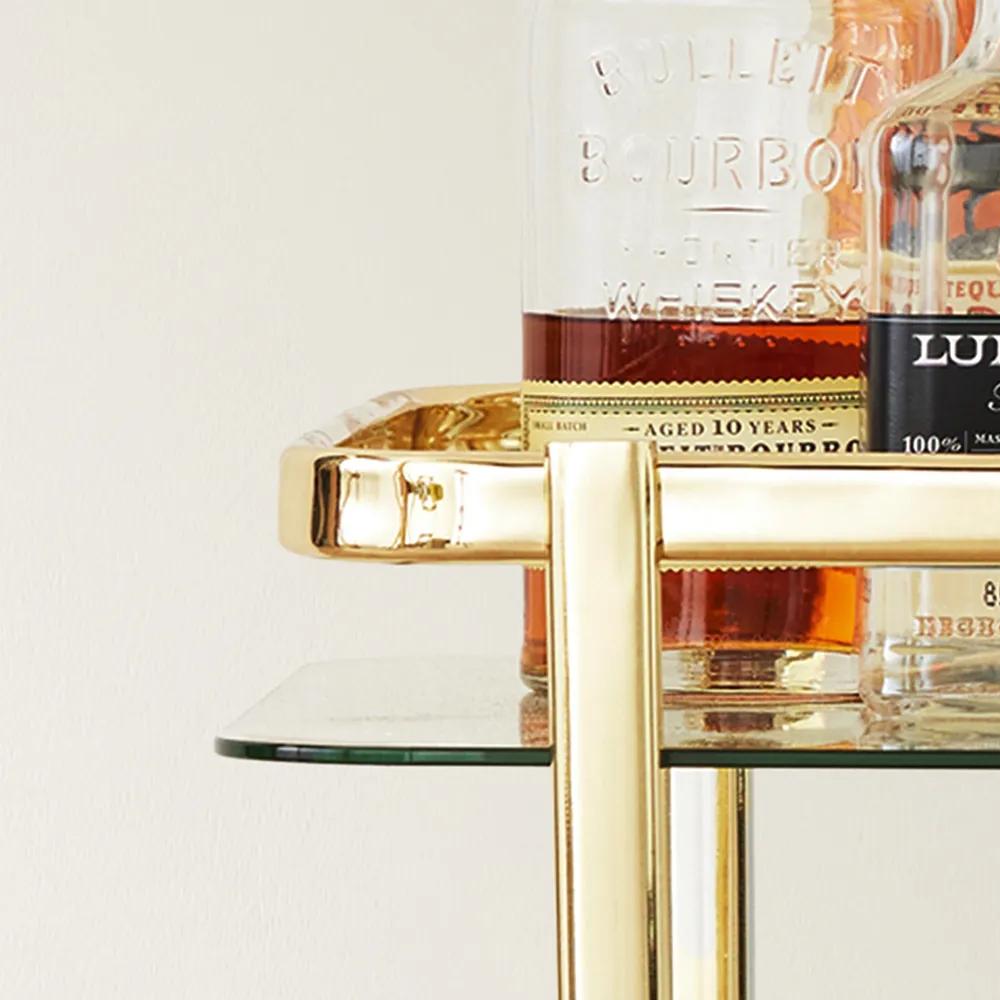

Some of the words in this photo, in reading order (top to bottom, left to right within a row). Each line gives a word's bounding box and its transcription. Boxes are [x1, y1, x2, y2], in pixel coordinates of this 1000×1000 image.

[604, 279, 866, 322] WHISKEY
[643, 422, 705, 437] AGED
[711, 418, 742, 436] 10
[748, 418, 817, 435] YEARS
[902, 435, 962, 455] 100%
